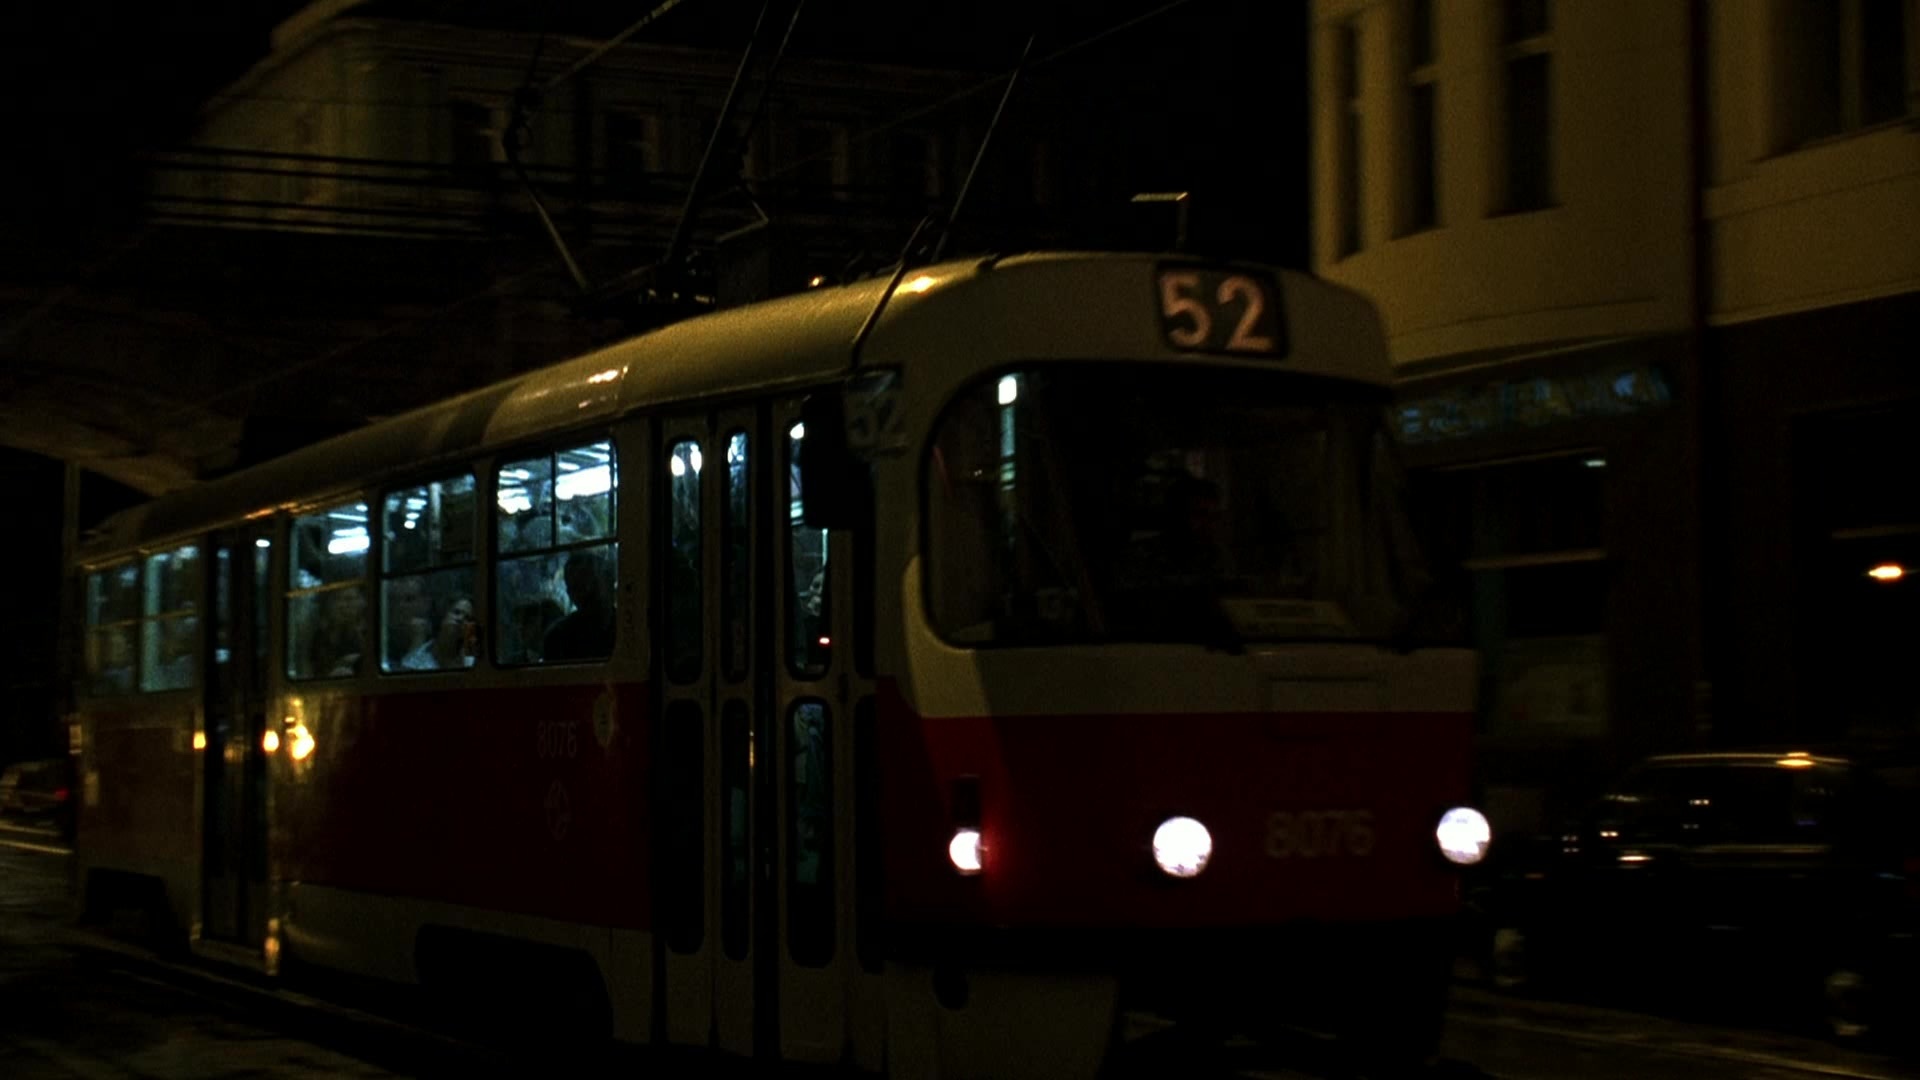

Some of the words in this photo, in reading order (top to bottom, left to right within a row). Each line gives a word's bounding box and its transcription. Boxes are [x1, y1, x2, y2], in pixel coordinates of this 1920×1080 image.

[1159, 271, 1275, 351] 52
[846, 392, 907, 448] 52
[537, 720, 578, 759] 8076
[1265, 808, 1376, 858] 8076
